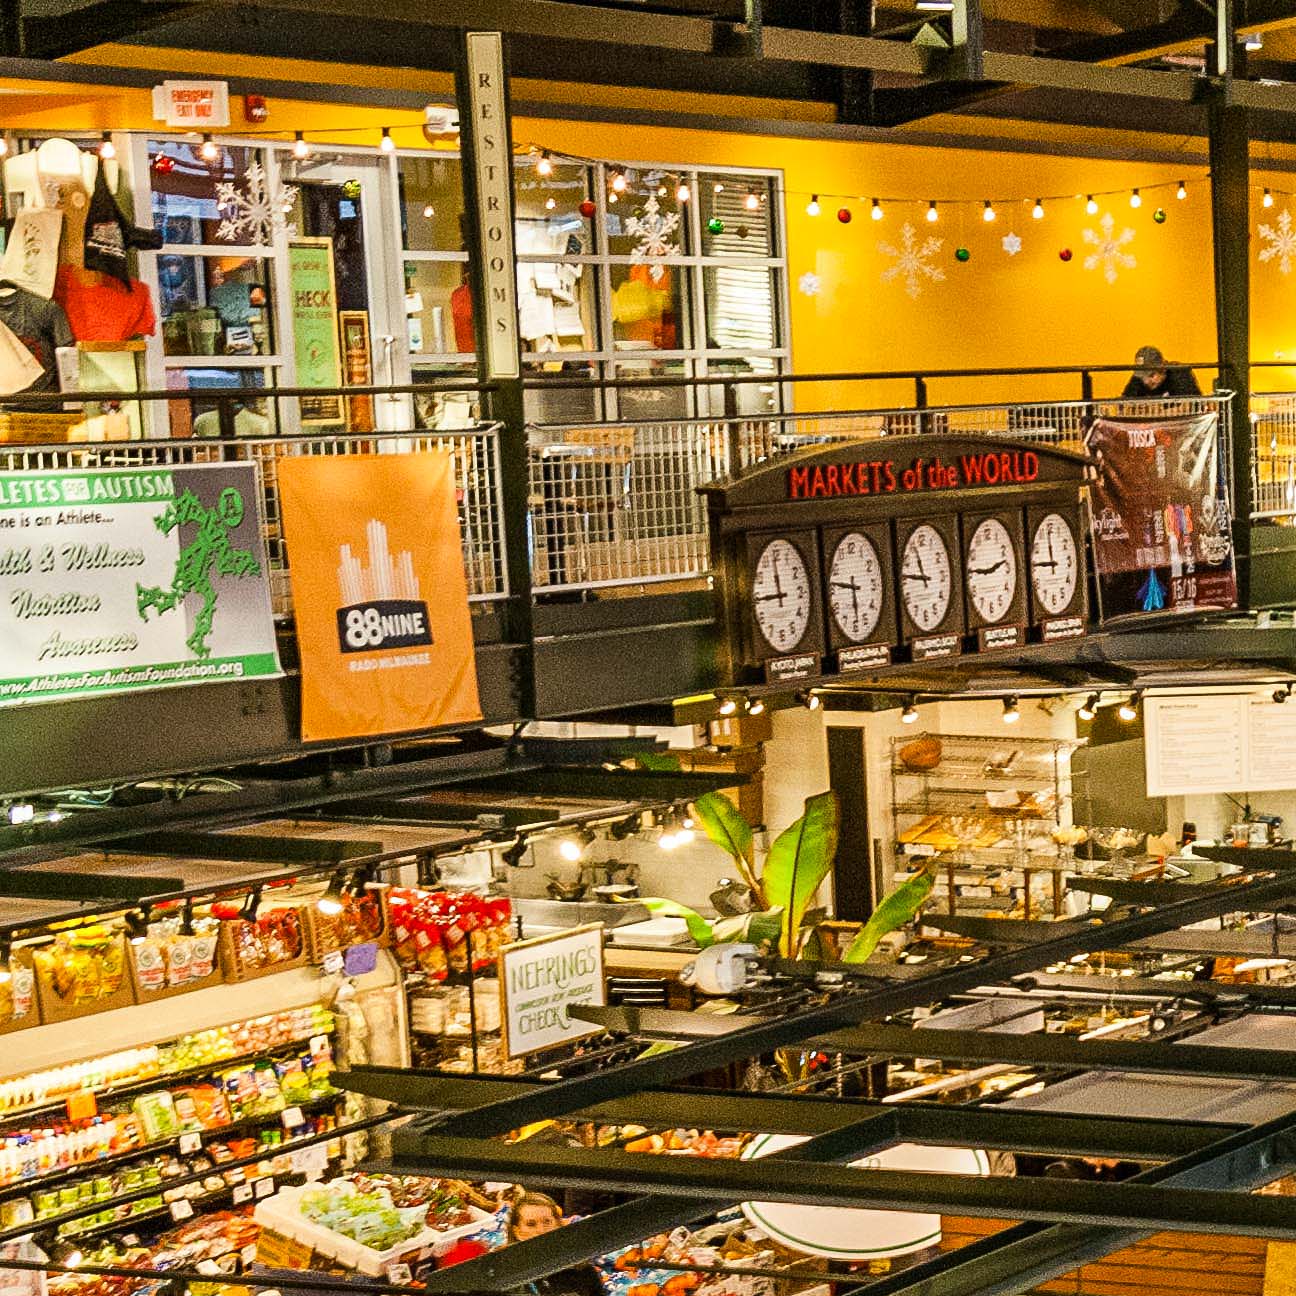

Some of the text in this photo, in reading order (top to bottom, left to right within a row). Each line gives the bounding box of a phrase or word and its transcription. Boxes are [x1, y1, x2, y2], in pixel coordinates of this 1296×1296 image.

[478, 72, 507, 333] RESTROOMS
[92, 474, 174, 499] AUTISM
[789, 450, 1040, 500] MARKETS of the WORLD
[20, 512, 31, 528] is
[34, 515, 52, 528] an
[61, 541, 146, 570] Wellness
[11, 586, 102, 619] Nutrition
[38, 630, 140, 661] Awareness
[519, 1005, 572, 1034] CHECK
